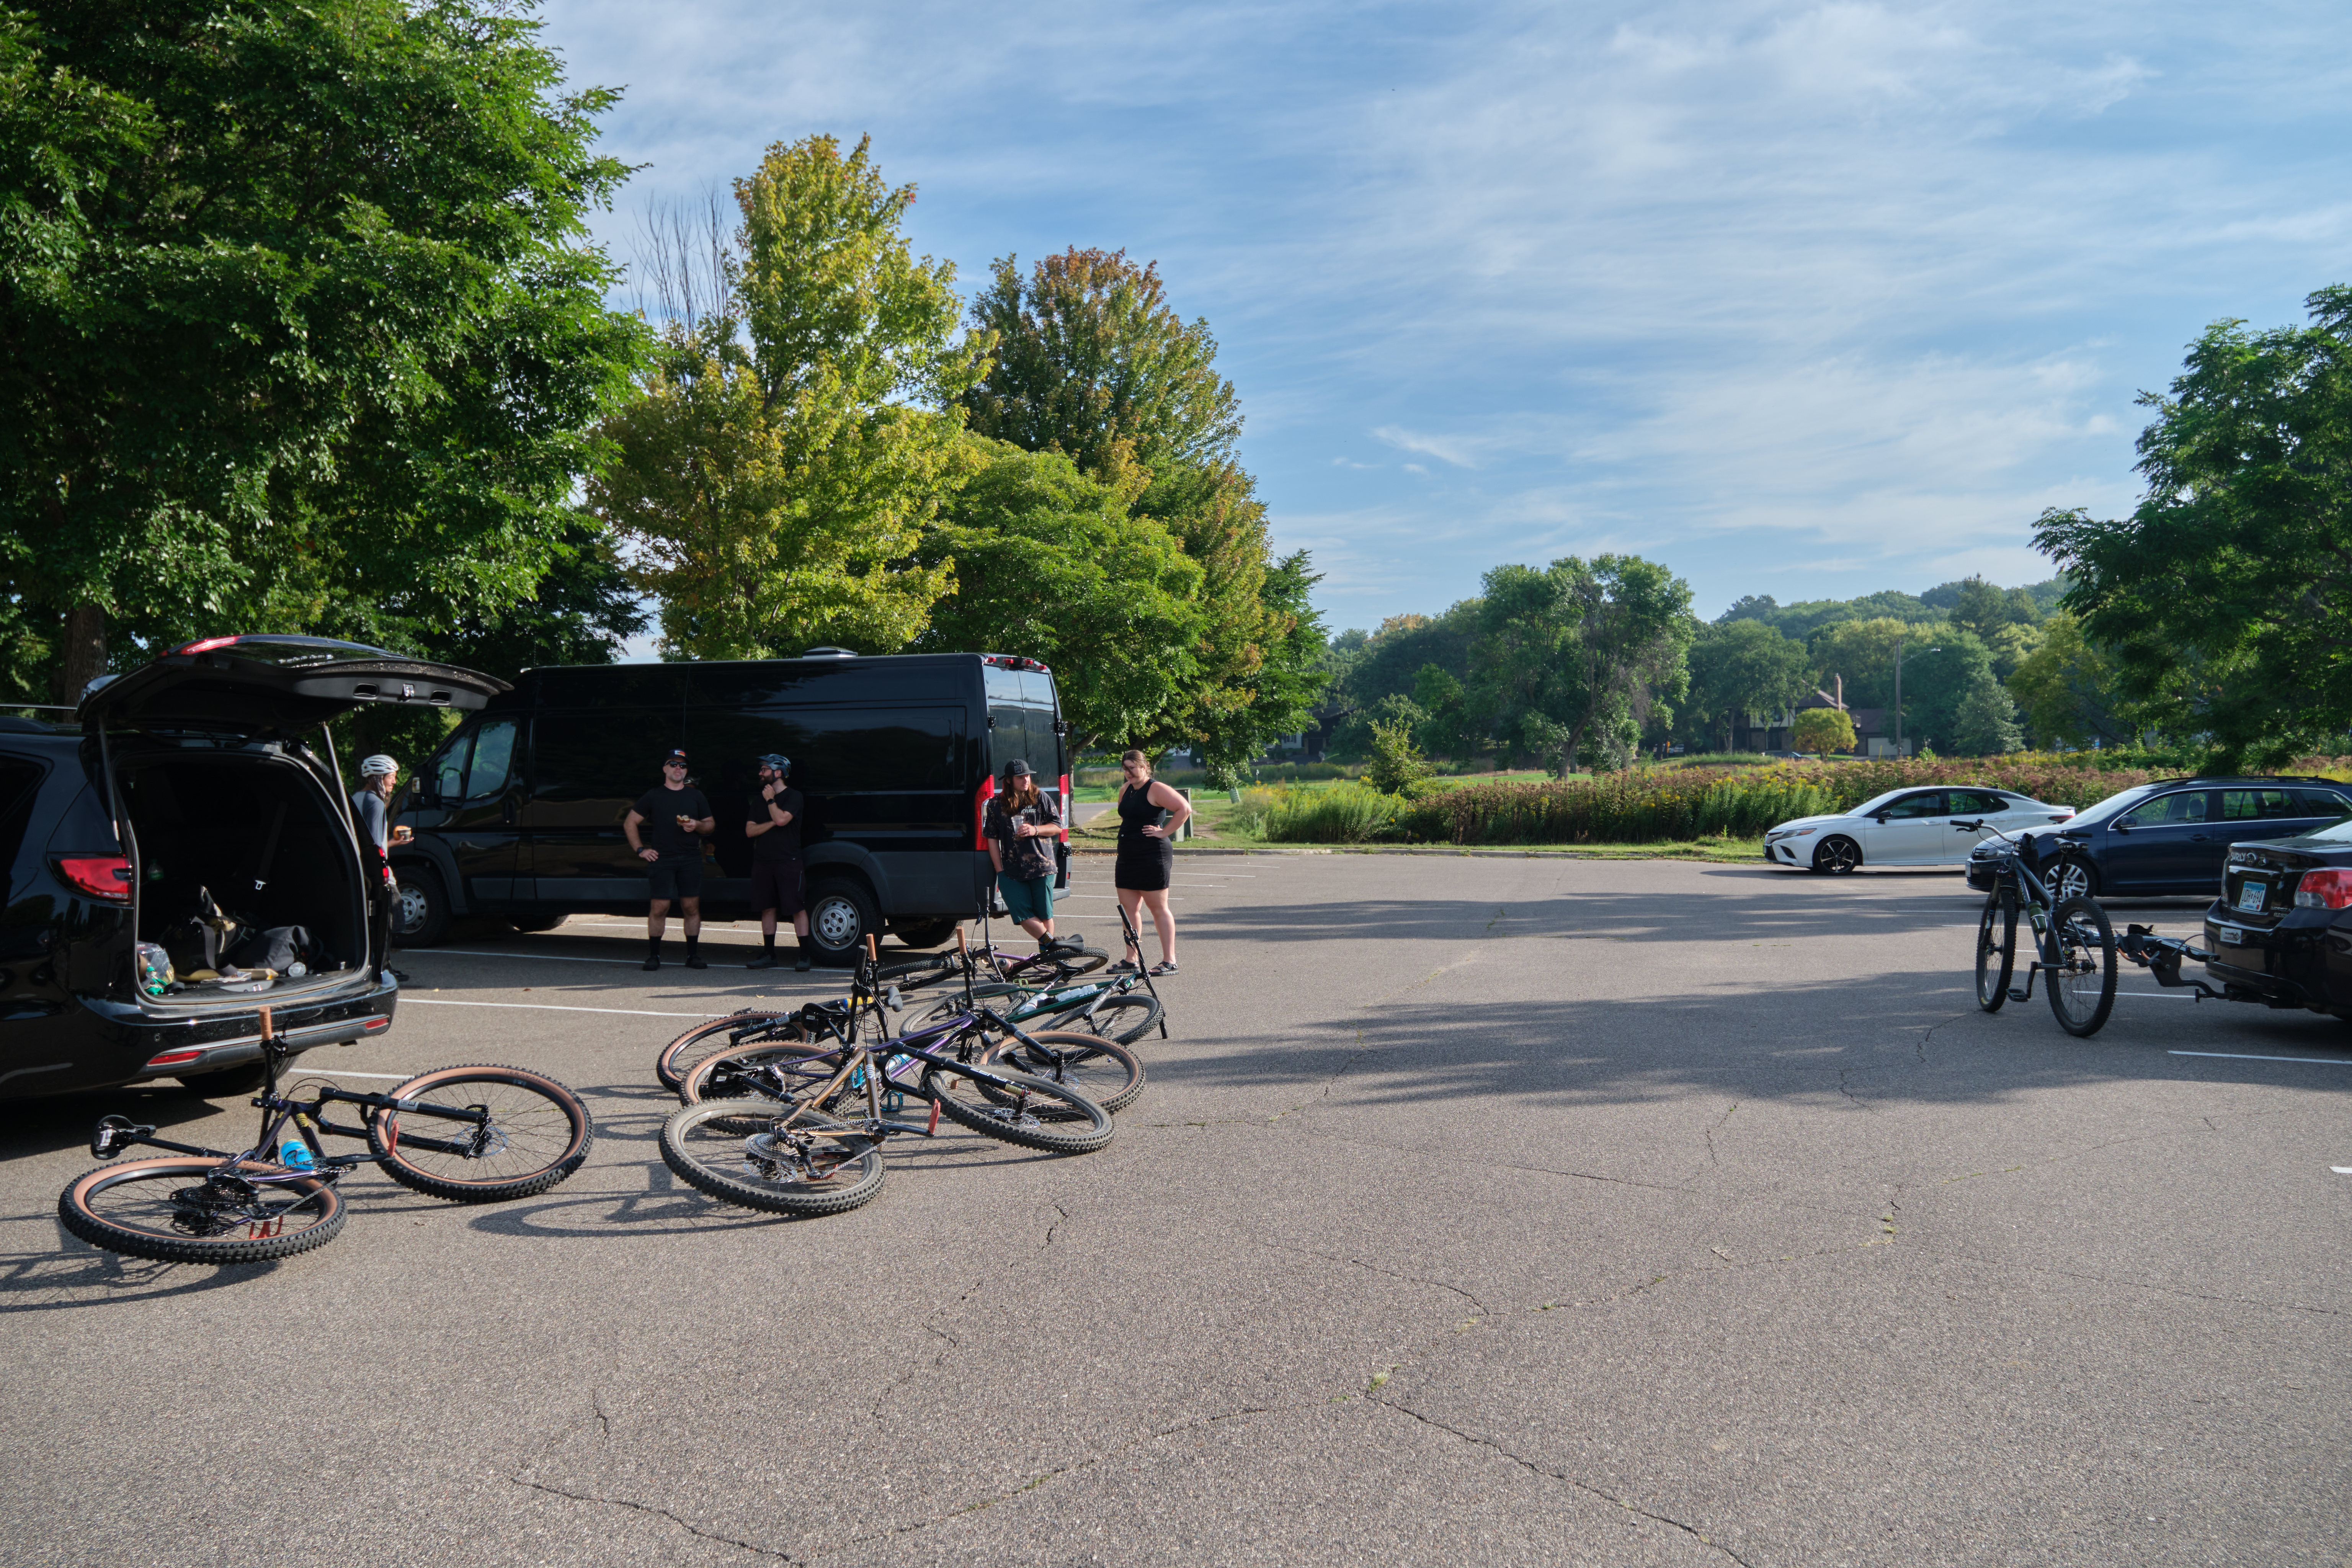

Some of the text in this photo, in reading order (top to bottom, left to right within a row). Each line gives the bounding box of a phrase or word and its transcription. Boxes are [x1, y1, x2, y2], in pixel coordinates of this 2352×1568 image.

[2230, 852, 2246, 862] SURLY
[505, 1070, 542, 1083] TERAVAIL
[694, 1101, 729, 1109] TERAVAIL
[216, 1159, 265, 1169] TERVAIL
